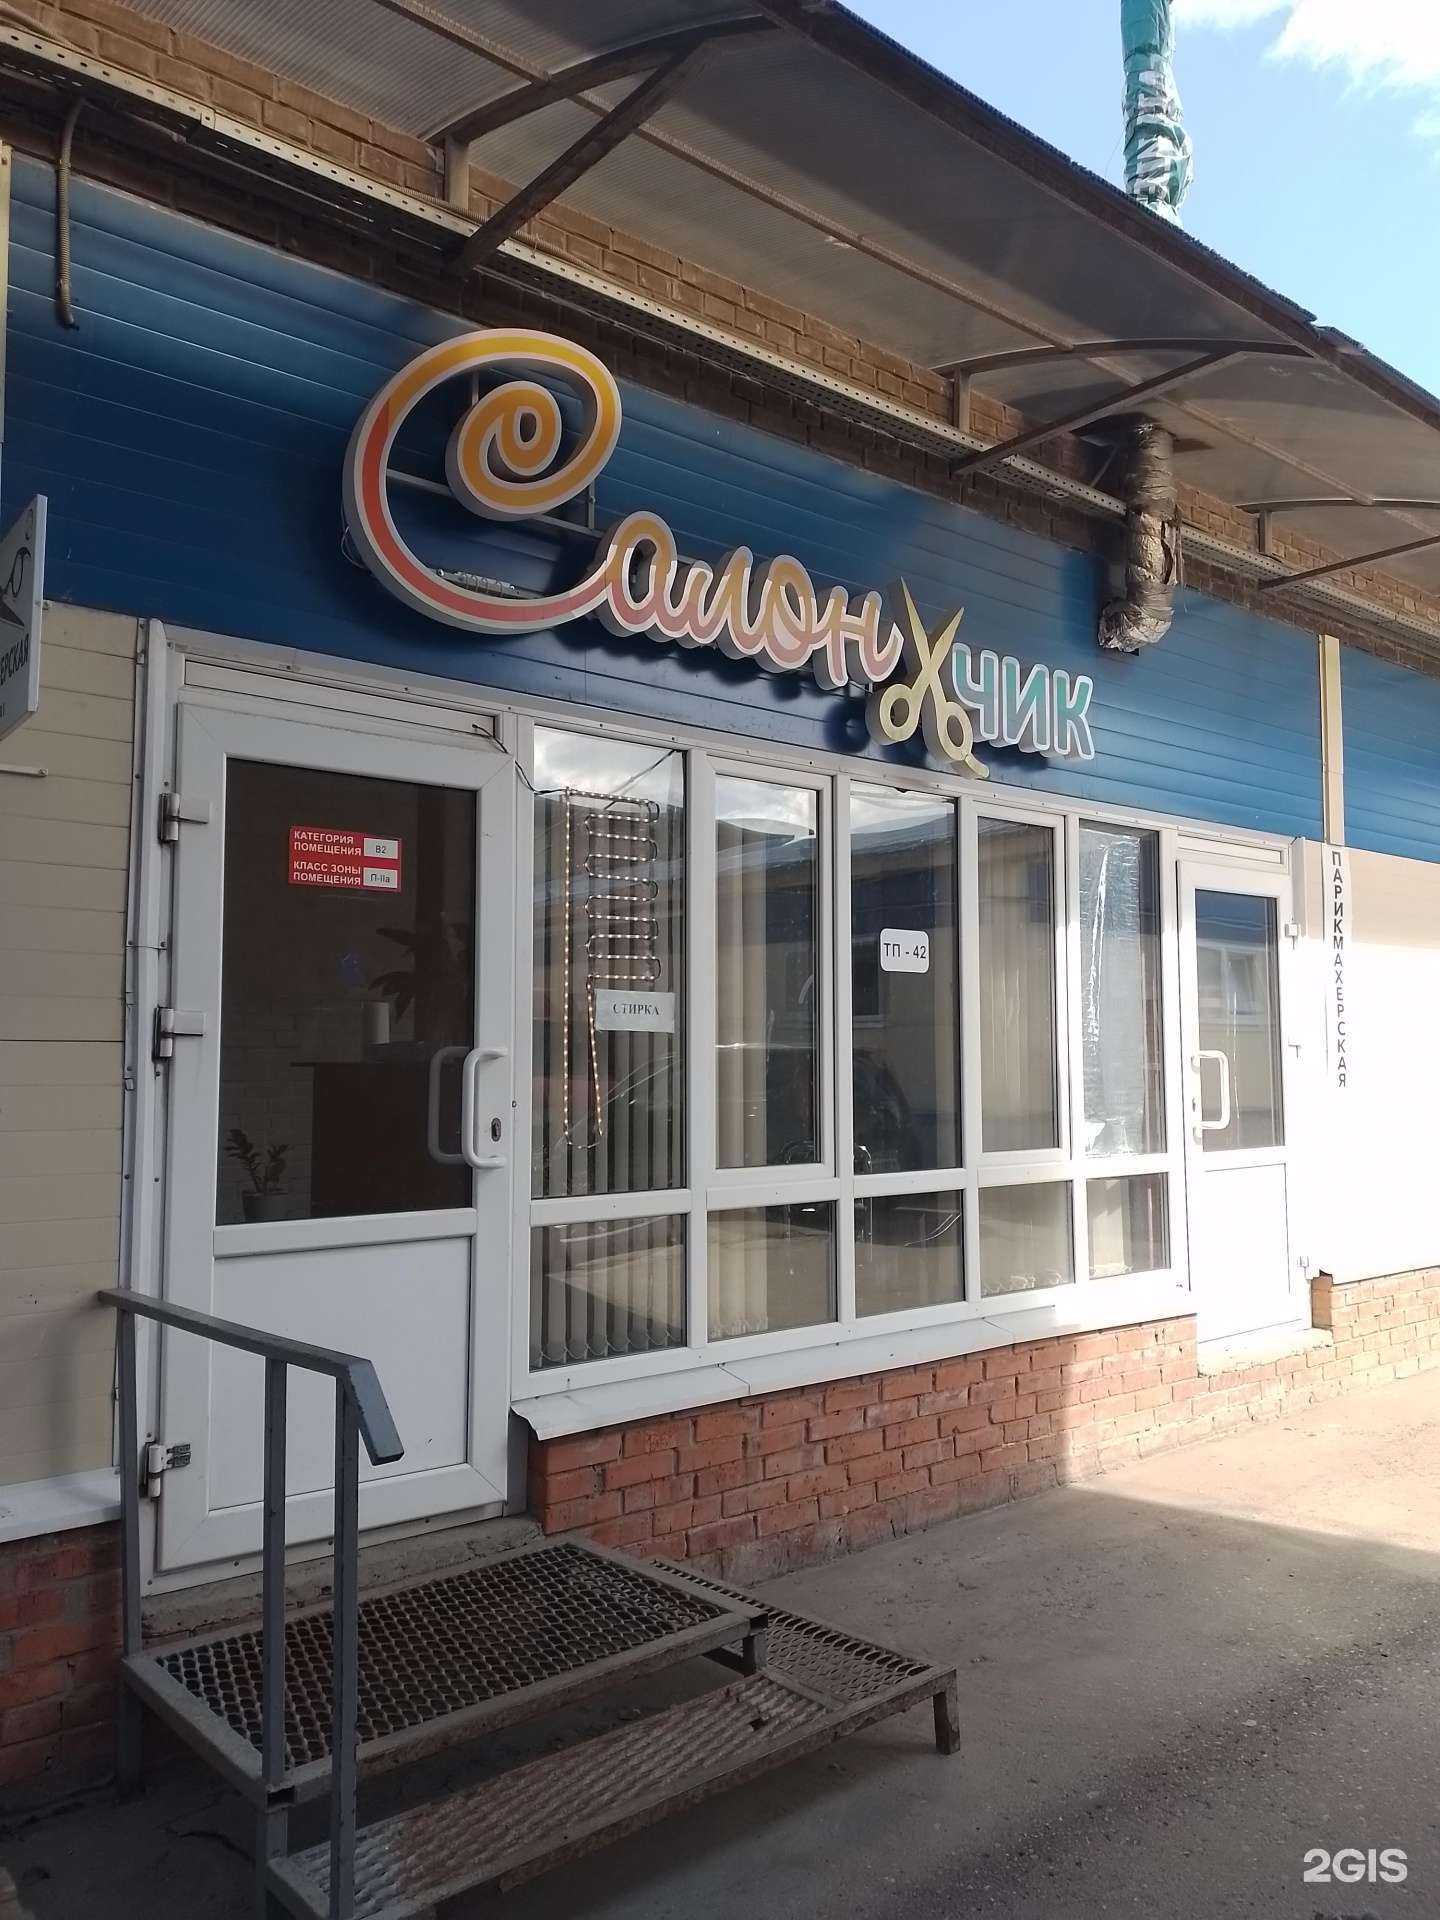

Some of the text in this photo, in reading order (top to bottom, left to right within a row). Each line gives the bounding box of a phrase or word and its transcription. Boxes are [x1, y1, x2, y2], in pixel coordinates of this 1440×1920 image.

[294, 830, 354, 845] КАТЕГОРИЯ
[294, 841, 362, 856] ПОМЕЩЕНИЯ
[293, 860, 361, 875] КЛАСС ЗОНЫ
[293, 871, 361, 886] ПОМЕЩЕНИЯ
[883, 942, 901, 958] ТП
[912, 945, 927, 959] 42
[1331, 850, 1346, 1088] ПАРИКМАХЕРСКАЯ
[613, 1003, 660, 1016] СТИРКА
